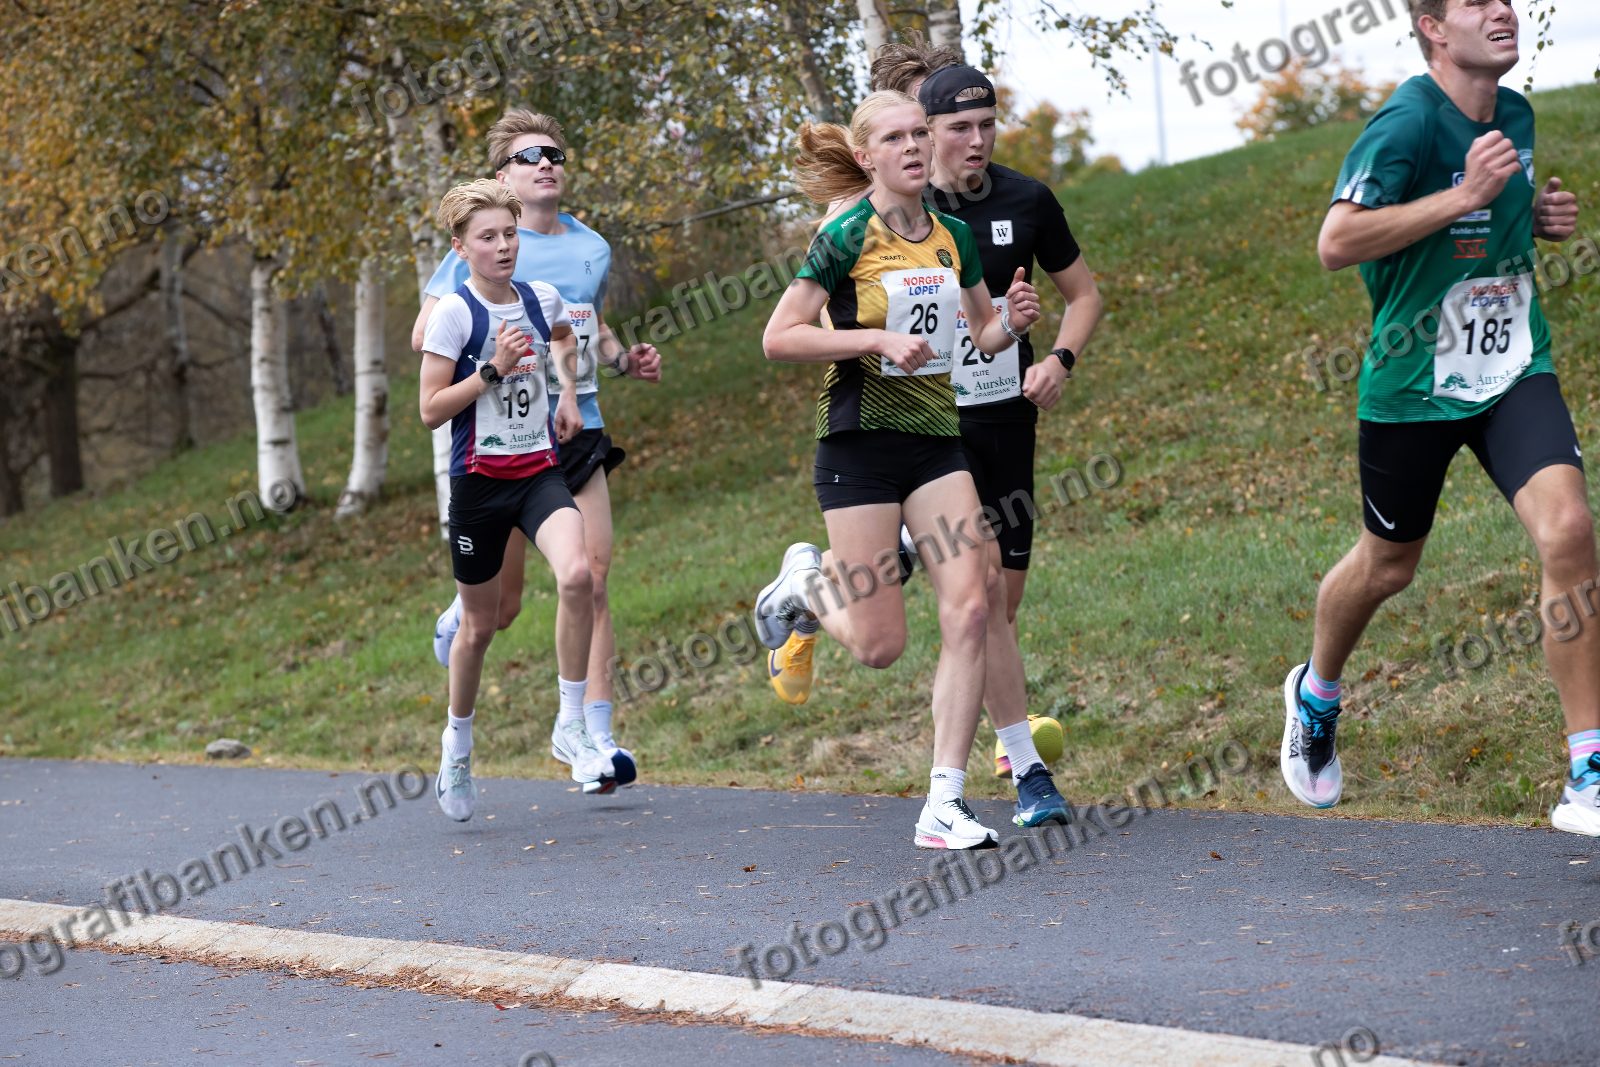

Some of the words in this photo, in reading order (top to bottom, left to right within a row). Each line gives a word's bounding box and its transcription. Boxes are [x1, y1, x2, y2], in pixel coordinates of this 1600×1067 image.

[903, 274, 945, 286] NORGES
[909, 285, 941, 297] LØPET
[1470, 282, 1519, 296] NORGES
[909, 302, 939, 335] 26
[1462, 317, 1513, 356] 185
[575, 335, 591, 361] 7
[972, 369, 991, 378] ELITE
[974, 375, 1018, 392] Aurskog
[502, 388, 530, 419] 19
